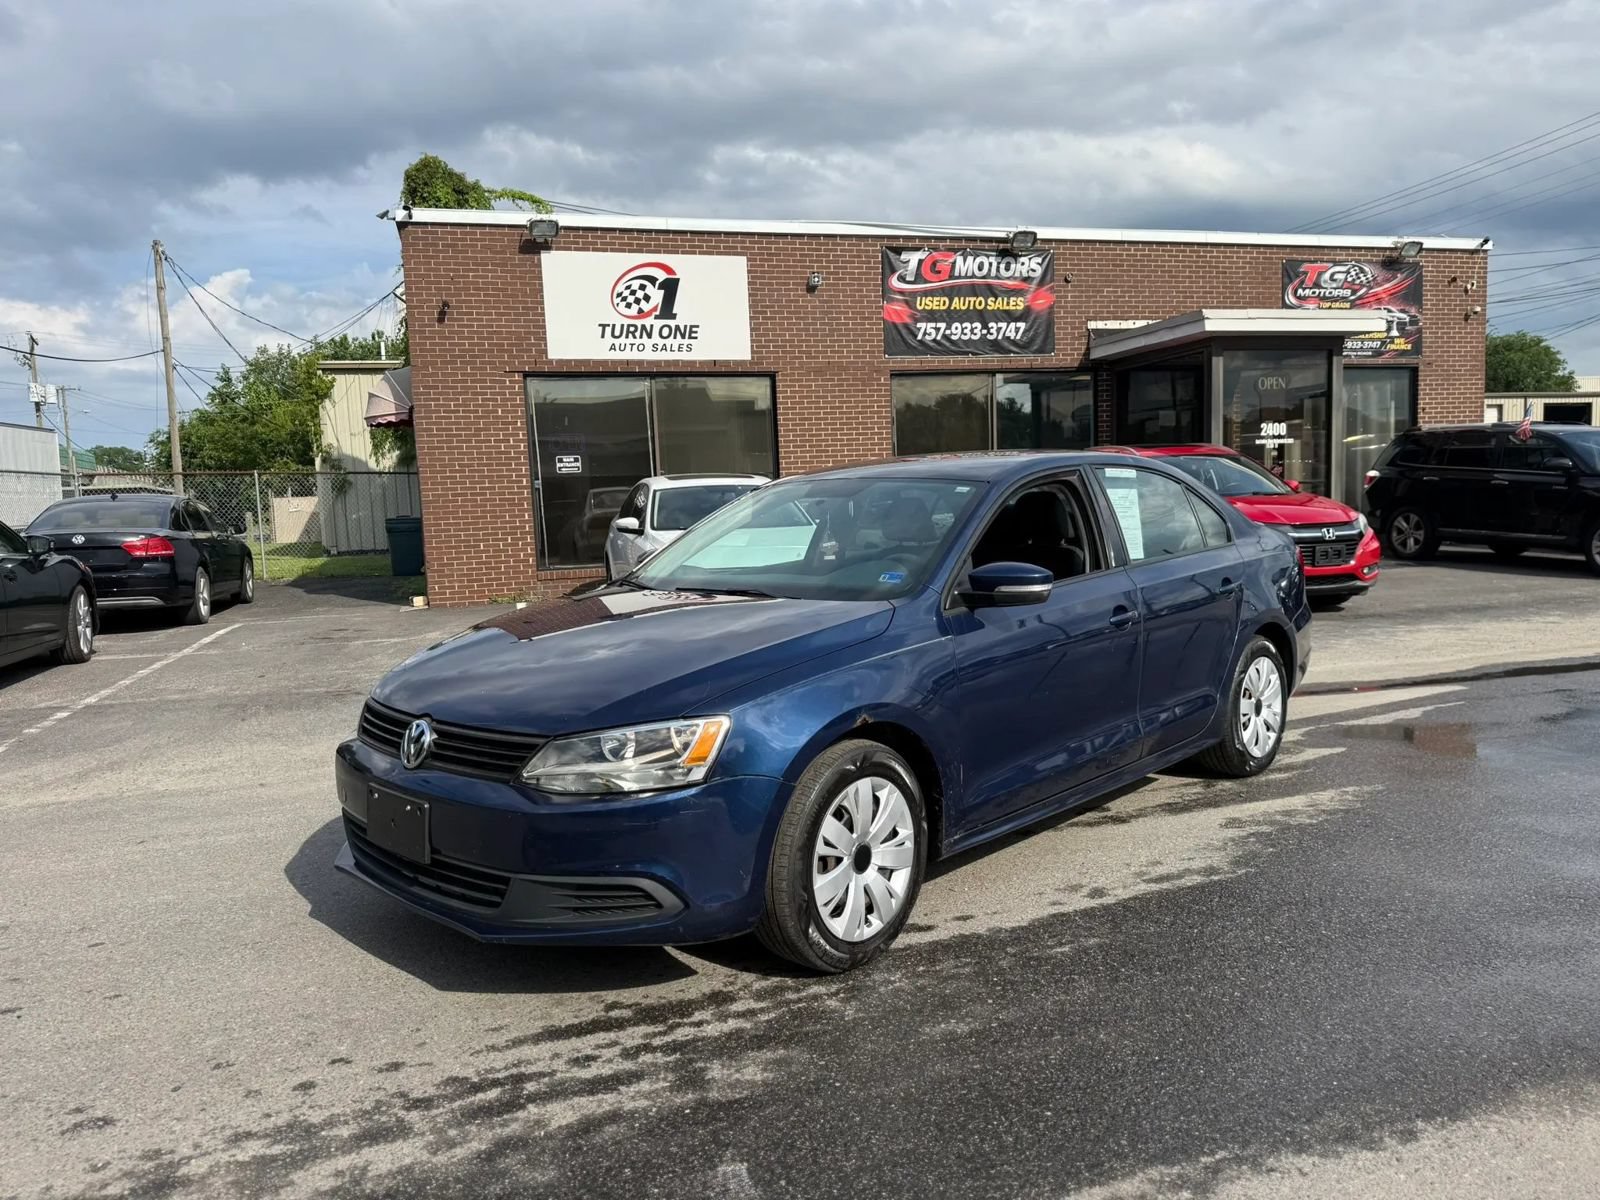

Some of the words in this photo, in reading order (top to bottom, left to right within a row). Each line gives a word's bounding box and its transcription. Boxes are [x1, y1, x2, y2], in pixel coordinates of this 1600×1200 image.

[900, 251, 956, 282] TG
[954, 255, 1043, 278] MOTORS
[1296, 288, 1352, 297] MOTORS
[916, 296, 950, 310] USED
[950, 297, 986, 310] AUTO
[986, 297, 1025, 310] SALES
[598, 323, 654, 340] TURN
[658, 323, 700, 340] ONE
[915, 321, 1026, 341] 757-933-3747
[608, 342, 646, 352] AUTO
[651, 342, 693, 353] SALES
[1258, 376, 1286, 390] OPEN
[1260, 422, 1287, 436] 2400
